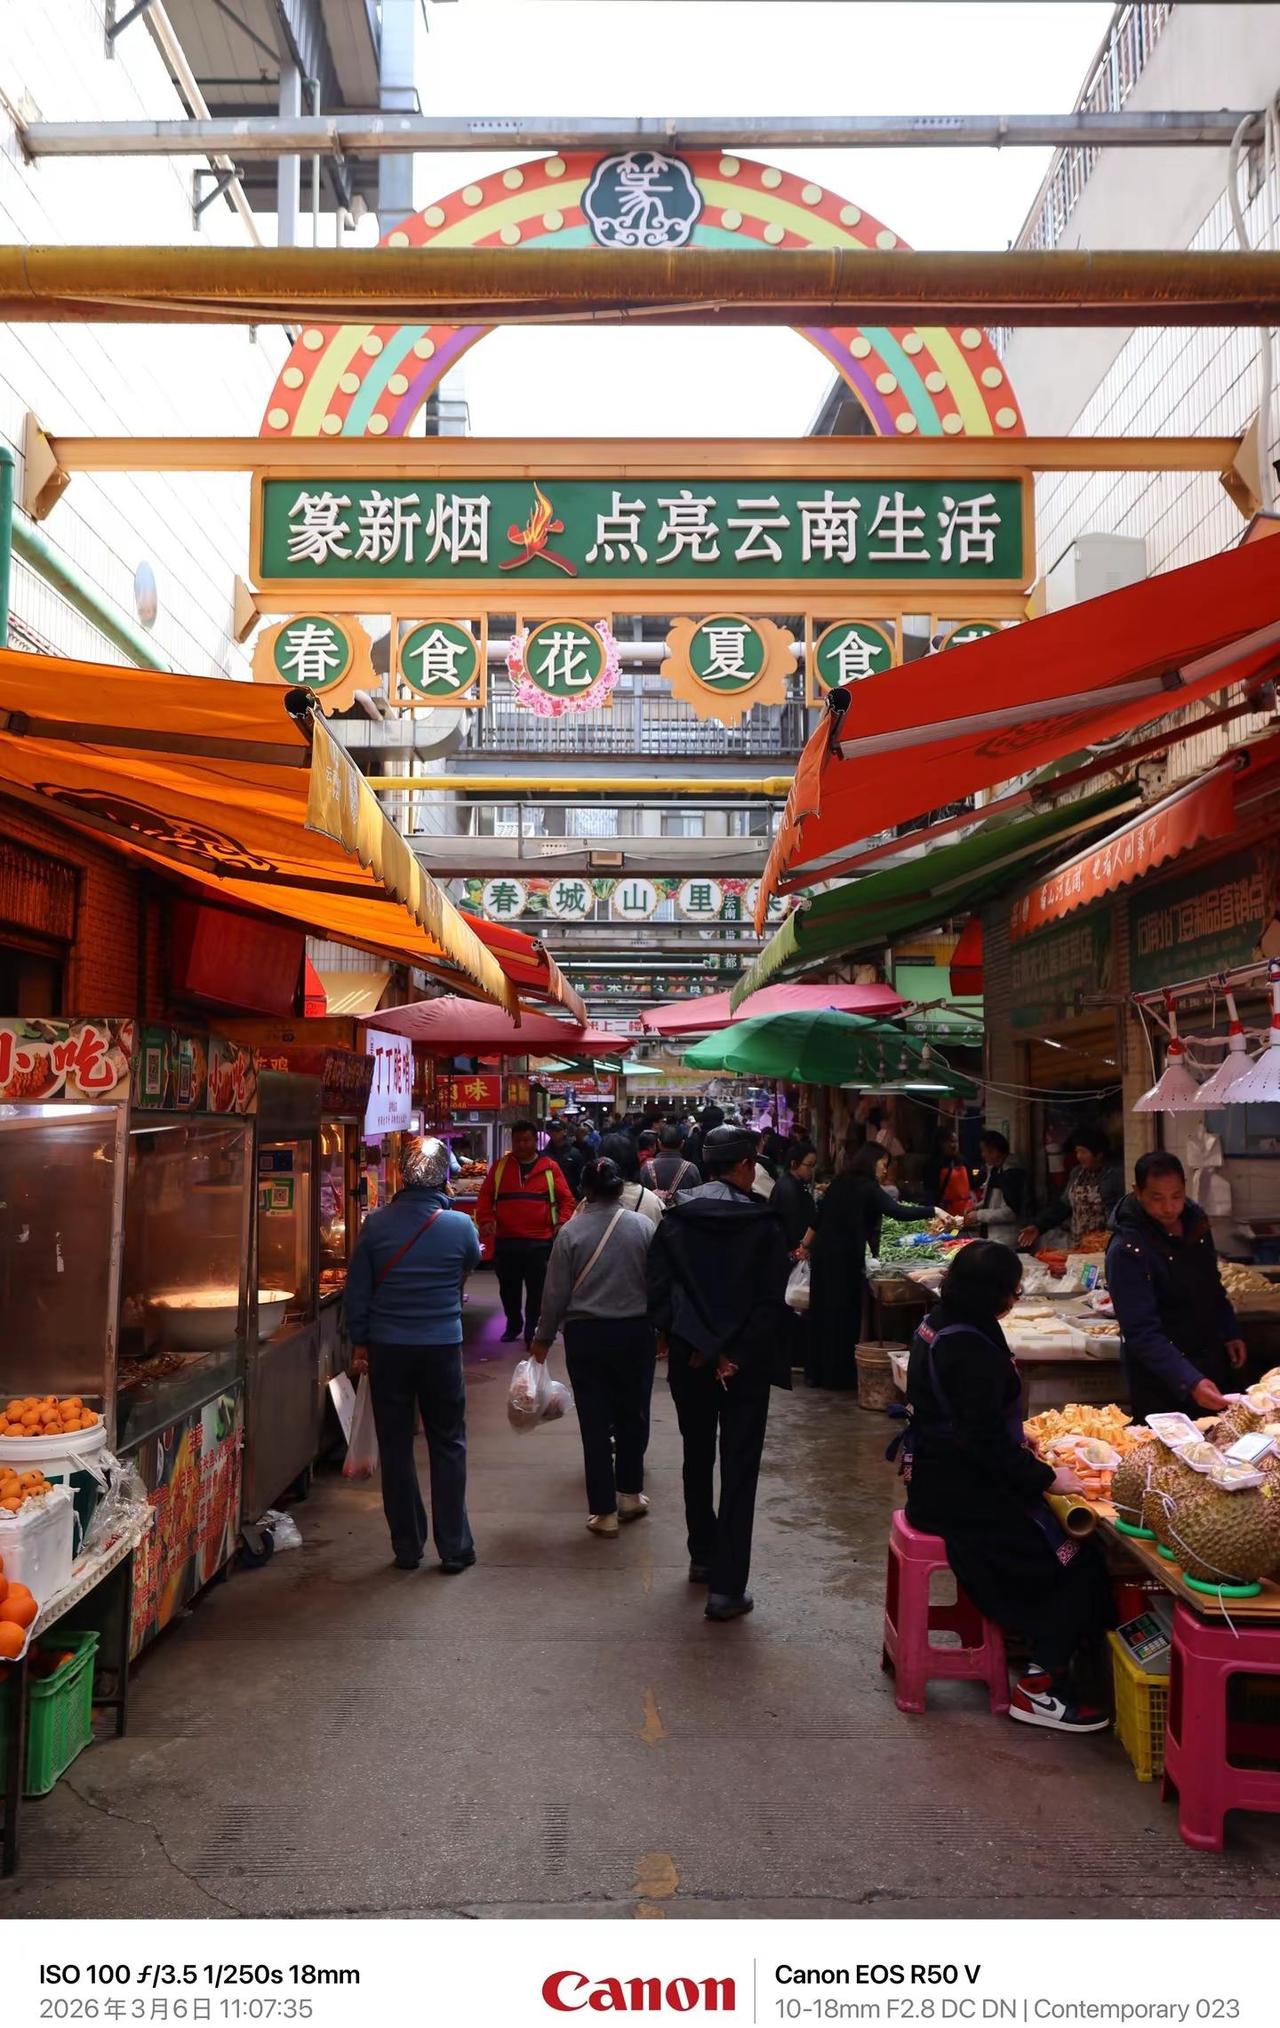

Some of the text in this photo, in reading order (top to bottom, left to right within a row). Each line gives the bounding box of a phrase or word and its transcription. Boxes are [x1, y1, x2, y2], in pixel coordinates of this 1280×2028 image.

[286, 481, 1001, 577] 篆新烟火点亮云南生活
[0, 1027, 116, 1089] 小吃
